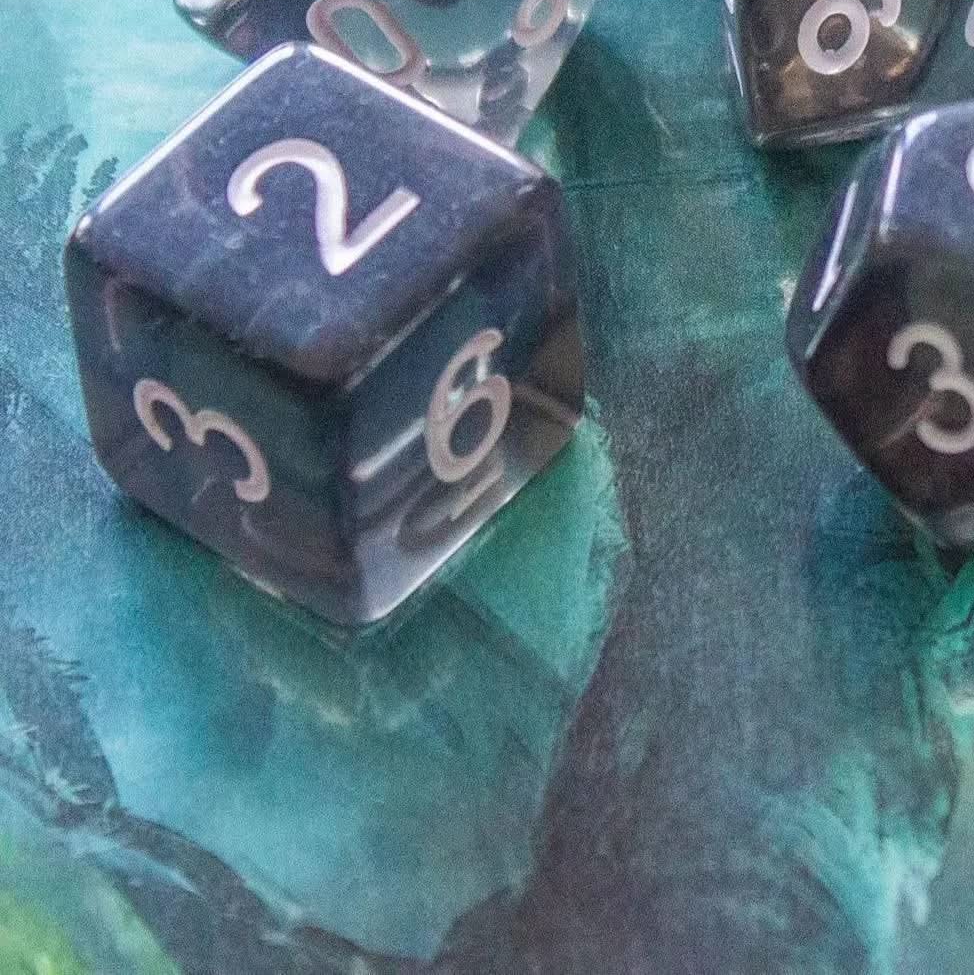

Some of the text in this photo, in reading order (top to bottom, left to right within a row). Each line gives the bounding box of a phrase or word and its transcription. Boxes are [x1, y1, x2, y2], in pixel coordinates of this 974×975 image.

[227, 138, 420, 275] 2
[133, 379, 271, 503] 3
[424, 329, 511, 482] 6
